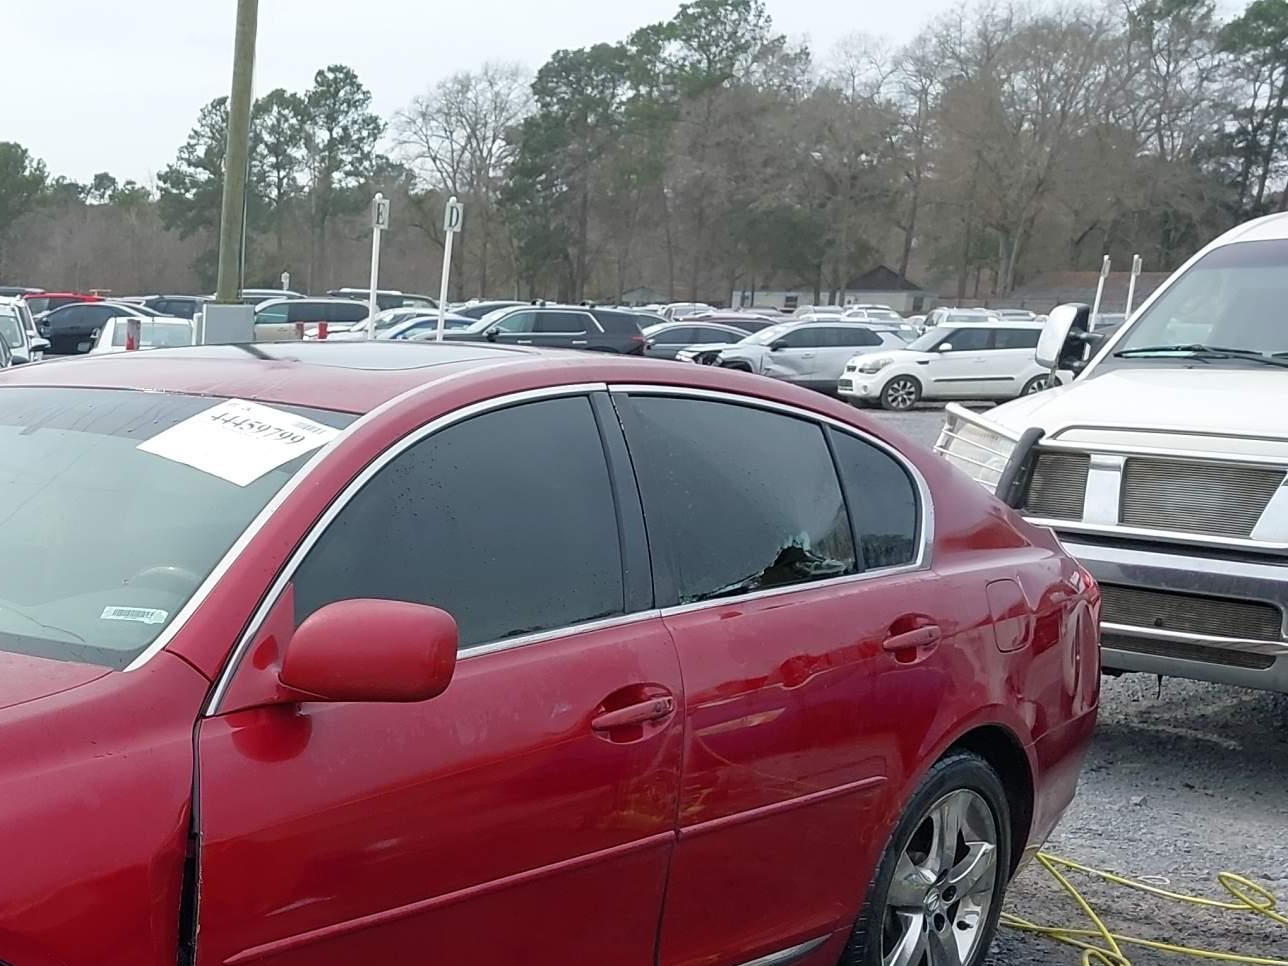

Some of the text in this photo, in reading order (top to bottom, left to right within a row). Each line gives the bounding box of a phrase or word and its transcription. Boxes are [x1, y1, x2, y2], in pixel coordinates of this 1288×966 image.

[376, 203, 386, 225] E
[448, 206, 460, 228] D
[210, 411, 306, 445] 44459799
